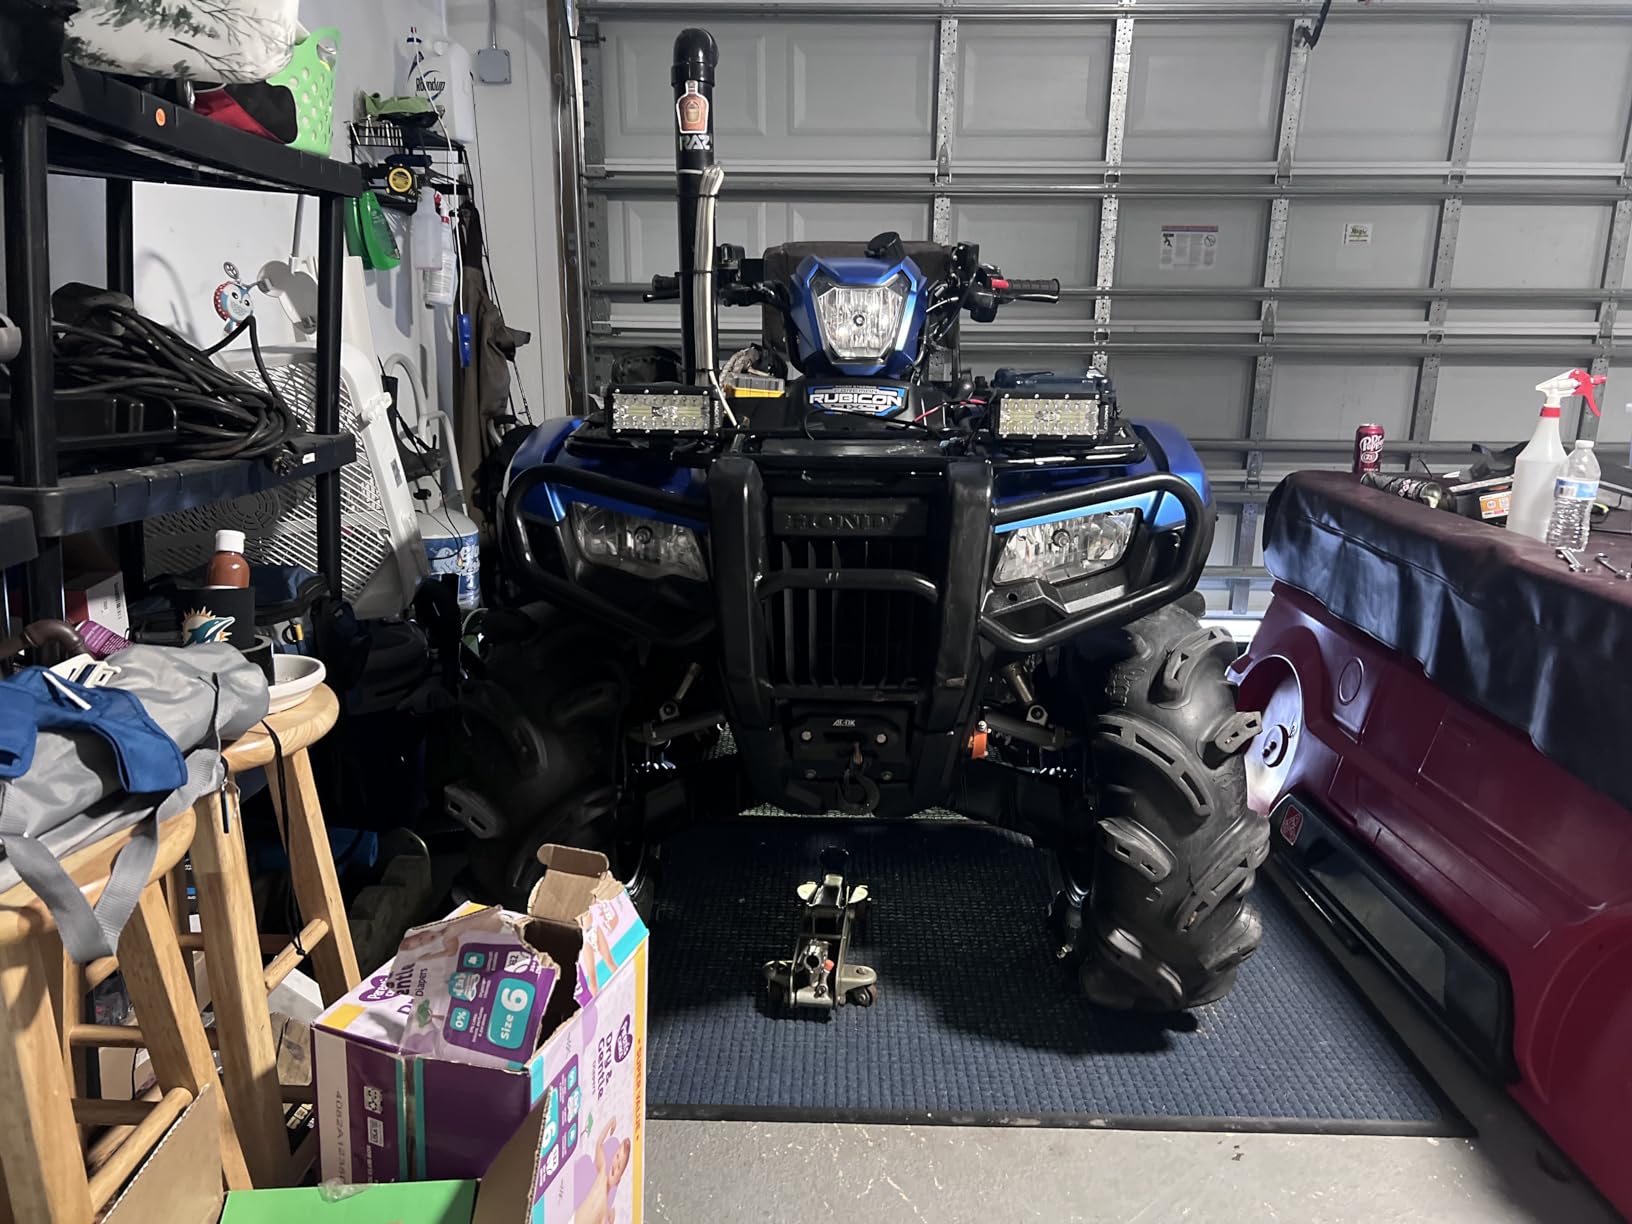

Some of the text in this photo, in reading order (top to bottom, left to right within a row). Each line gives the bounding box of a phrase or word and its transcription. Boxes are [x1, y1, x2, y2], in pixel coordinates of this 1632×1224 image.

[809, 393, 902, 407] RUBICON
[415, 968, 428, 997] Diapers
[455, 1008, 467, 1028] 0%
[500, 987, 528, 1040] size 6
[604, 1031, 613, 1085] Dry &
